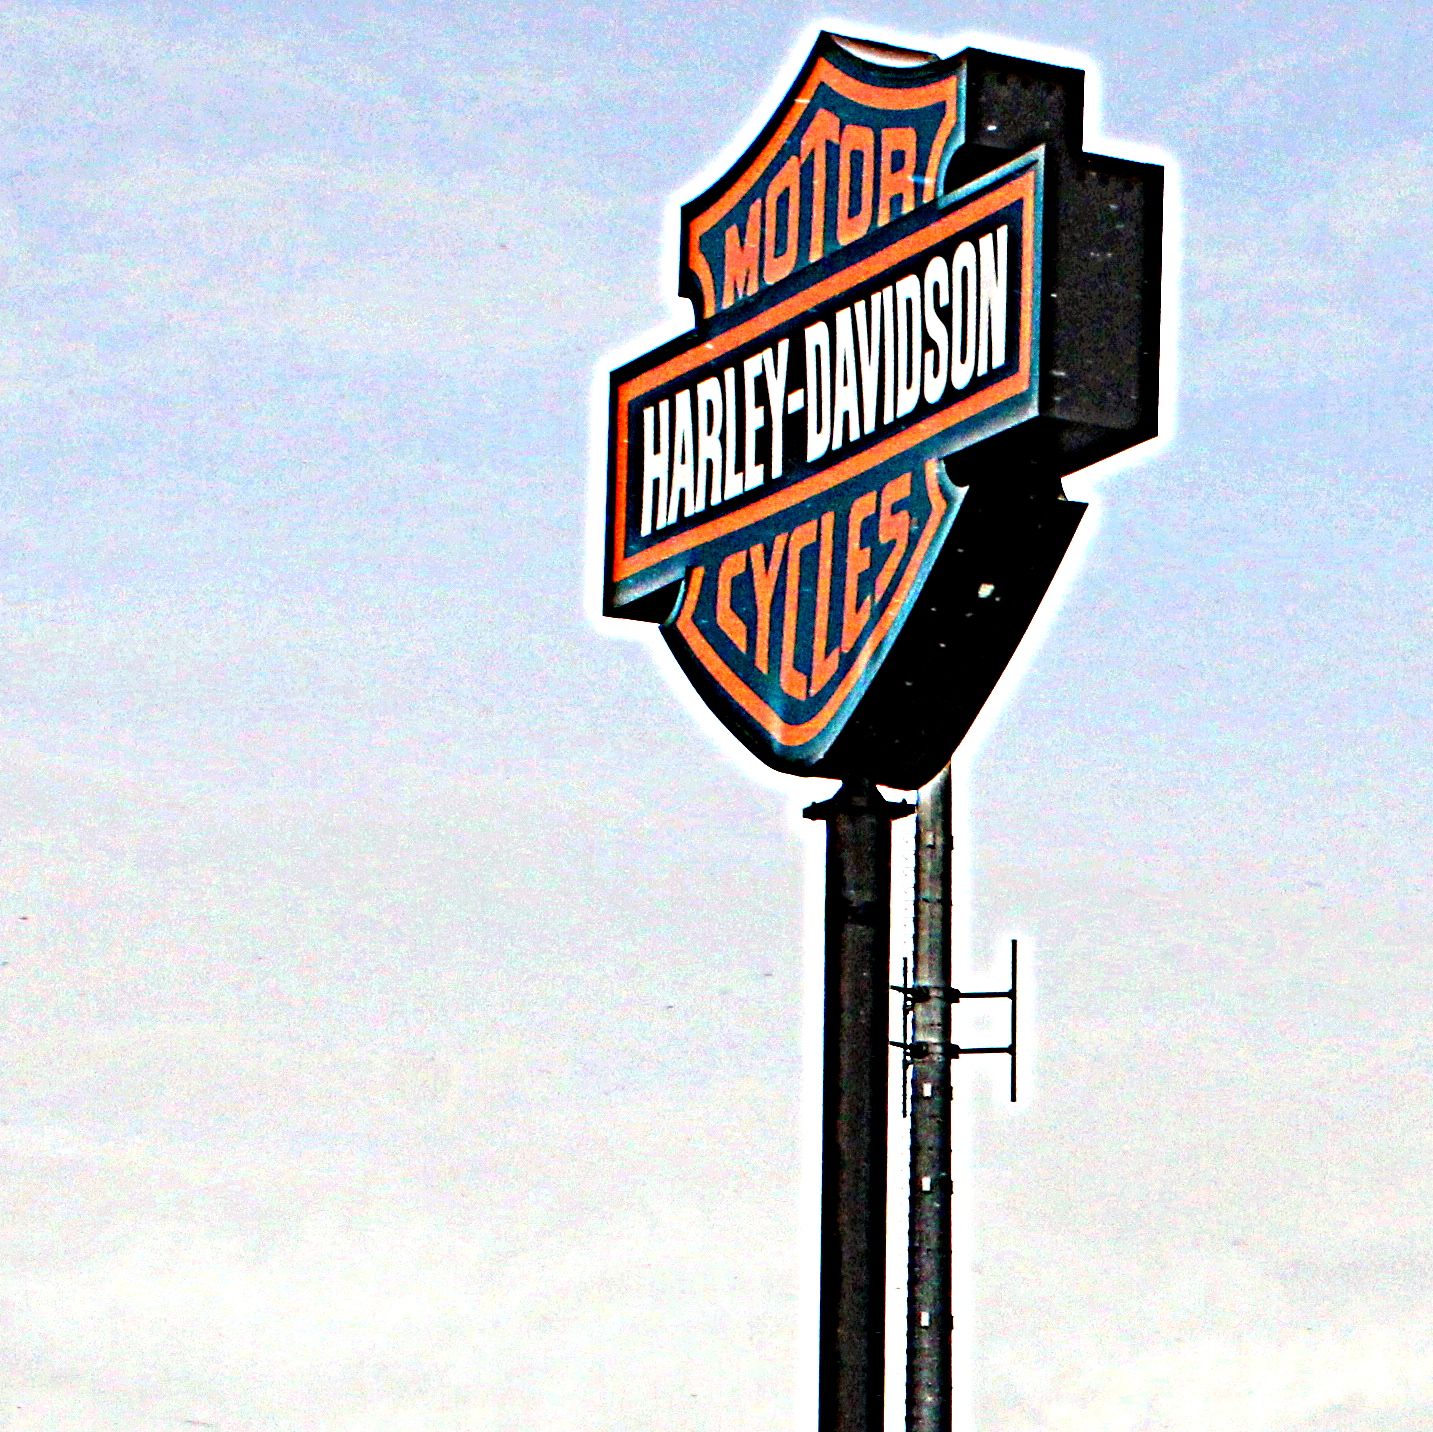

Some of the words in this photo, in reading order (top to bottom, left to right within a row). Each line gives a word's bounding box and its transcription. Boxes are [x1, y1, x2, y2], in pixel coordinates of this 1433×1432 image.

[722, 108, 917, 309] MOTOR
[640, 224, 1008, 537] HARLEY-DAVIDSON
[715, 470, 913, 701] CYCLES
